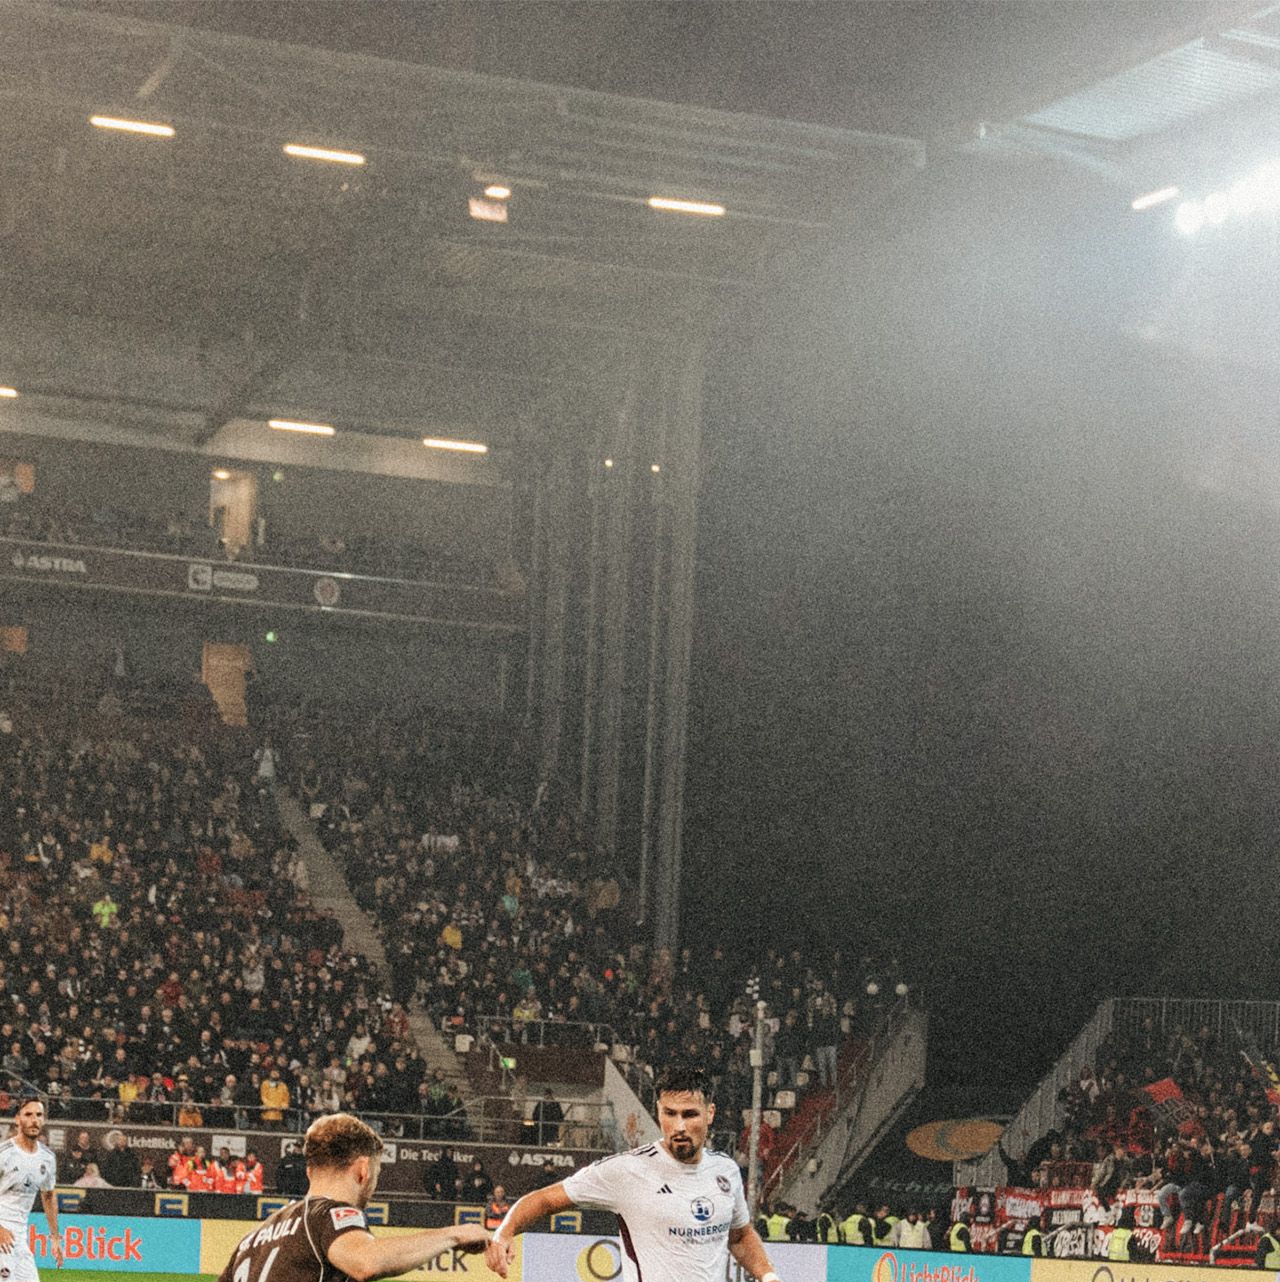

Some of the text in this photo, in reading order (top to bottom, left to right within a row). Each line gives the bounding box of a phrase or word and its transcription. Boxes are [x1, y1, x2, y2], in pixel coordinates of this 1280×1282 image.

[401, 1148, 474, 1164] Die Teciker
[520, 1154, 575, 1168] ASTRA
[252, 1216, 302, 1248] PAULI
